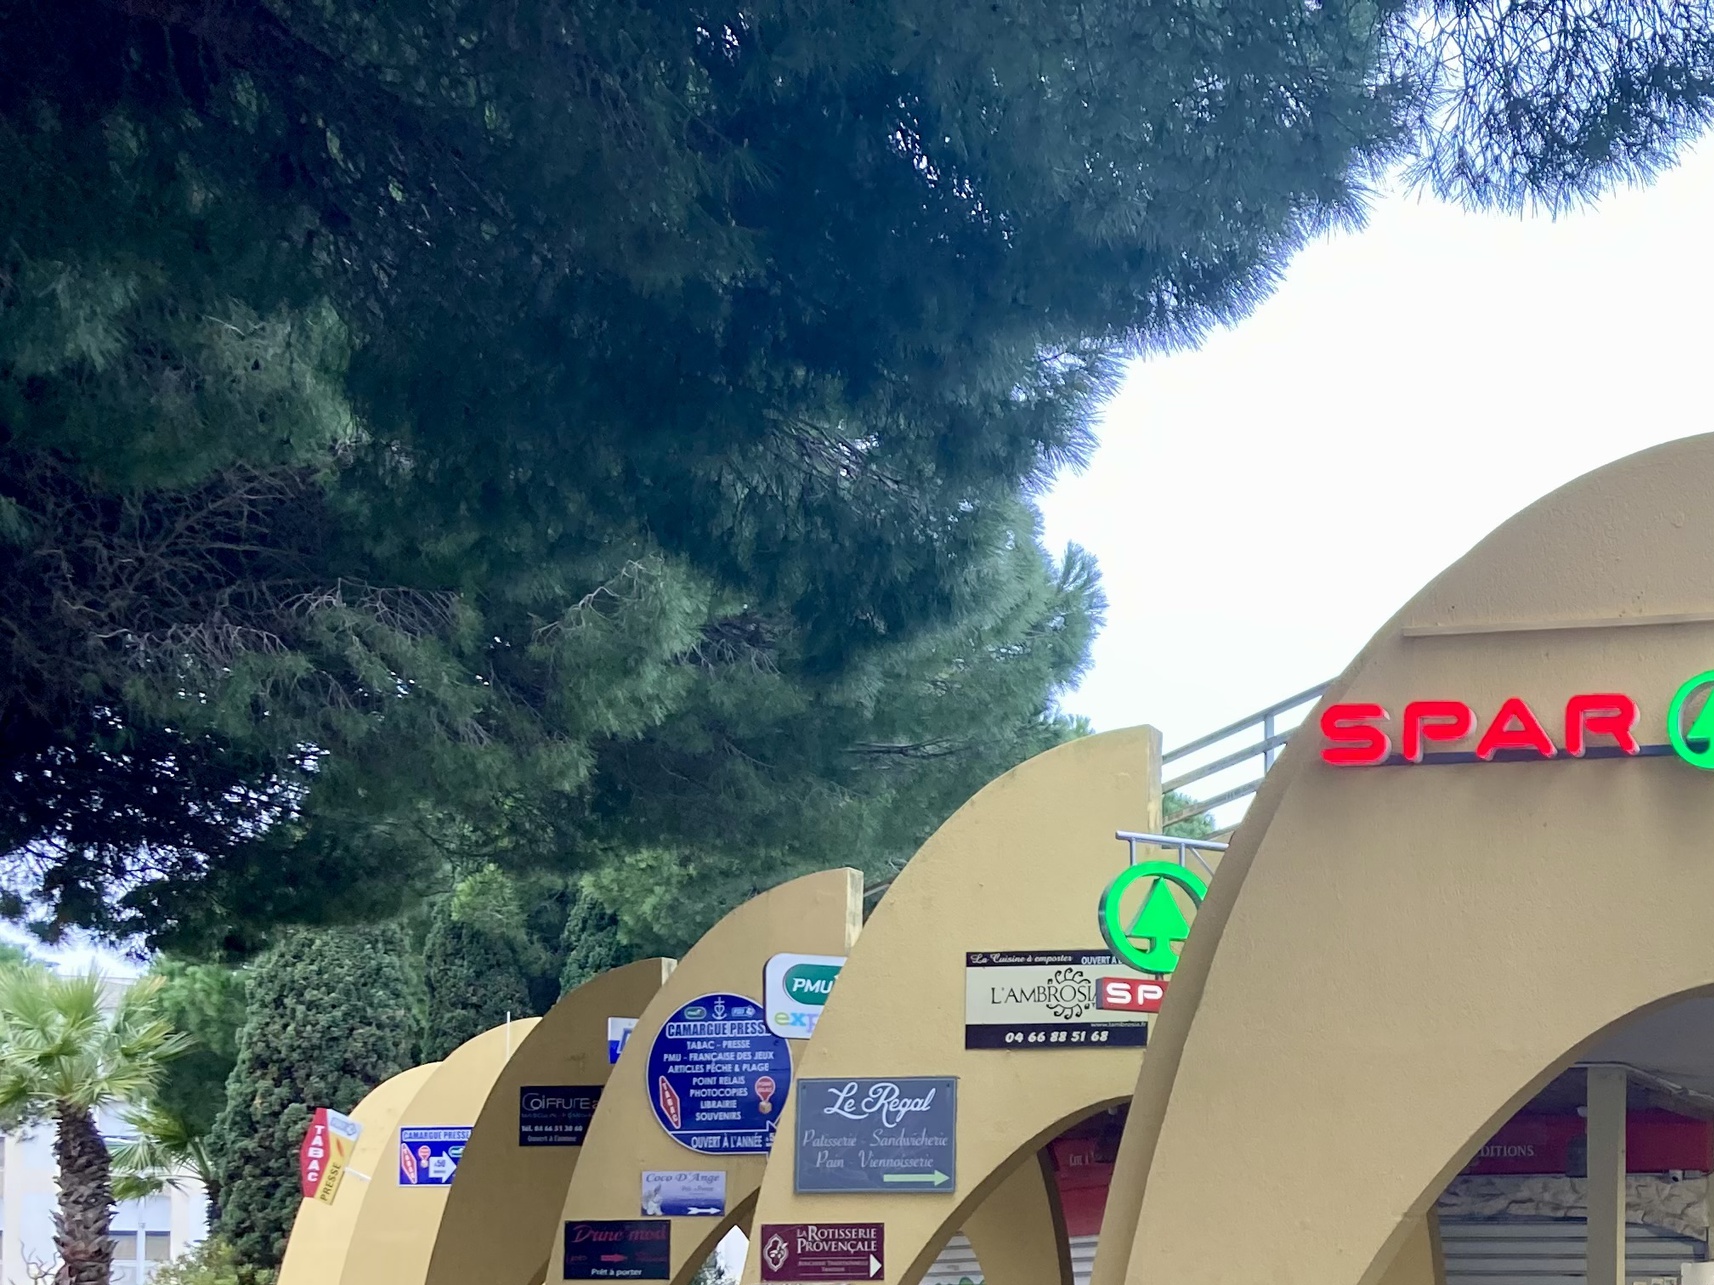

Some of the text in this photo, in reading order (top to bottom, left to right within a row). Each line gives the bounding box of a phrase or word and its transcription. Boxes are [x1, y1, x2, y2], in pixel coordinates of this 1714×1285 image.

[1321, 693, 1640, 766] SPAR
[970, 954, 987, 964] La
[990, 953, 1025, 963] Cuisine
[1034, 953, 1073, 965] emporter
[1081, 956, 1110, 965] OUVERT
[792, 977, 835, 995] PMU
[668, 1022, 728, 1037] CAMARGUE
[1005, 1031, 1110, 1043] 04 66 88 51 68
[686, 1041, 716, 1050] TABAC
[722, 1040, 750, 1049] PRESSE
[663, 1054, 682, 1062] PMU
[689, 1052, 735, 1063] FRANÇAISE
[736, 1051, 752, 1060] DES
[754, 1051, 774, 1060] JEUX
[667, 1065, 704, 1073] ARTICLES
[742, 1063, 769, 1071] PLAGE
[692, 1076, 746, 1086] POINT RELAIS
[689, 1088, 748, 1098] PHOTOCOPIES
[700, 1100, 737, 1109] LIBRAIRIE
[823, 1082, 936, 1128] Le Regal
[695, 1112, 742, 1121] SOUVENIRS
[403, 1131, 442, 1140] CAMARGUE
[691, 1135, 720, 1149] OUVERT
[731, 1132, 763, 1147] L'ANNÉE
[869, 1128, 949, 1147] Sandwicherie
[305, 1124, 325, 1182] TABAC
[815, 1150, 845, 1168] Pain
[319, 1162, 342, 1202] PRESSE
[646, 1173, 673, 1183] Coco
[796, 1226, 877, 1241] LA ROTISSERIE
[796, 1239, 877, 1254] PROVENÇALE
